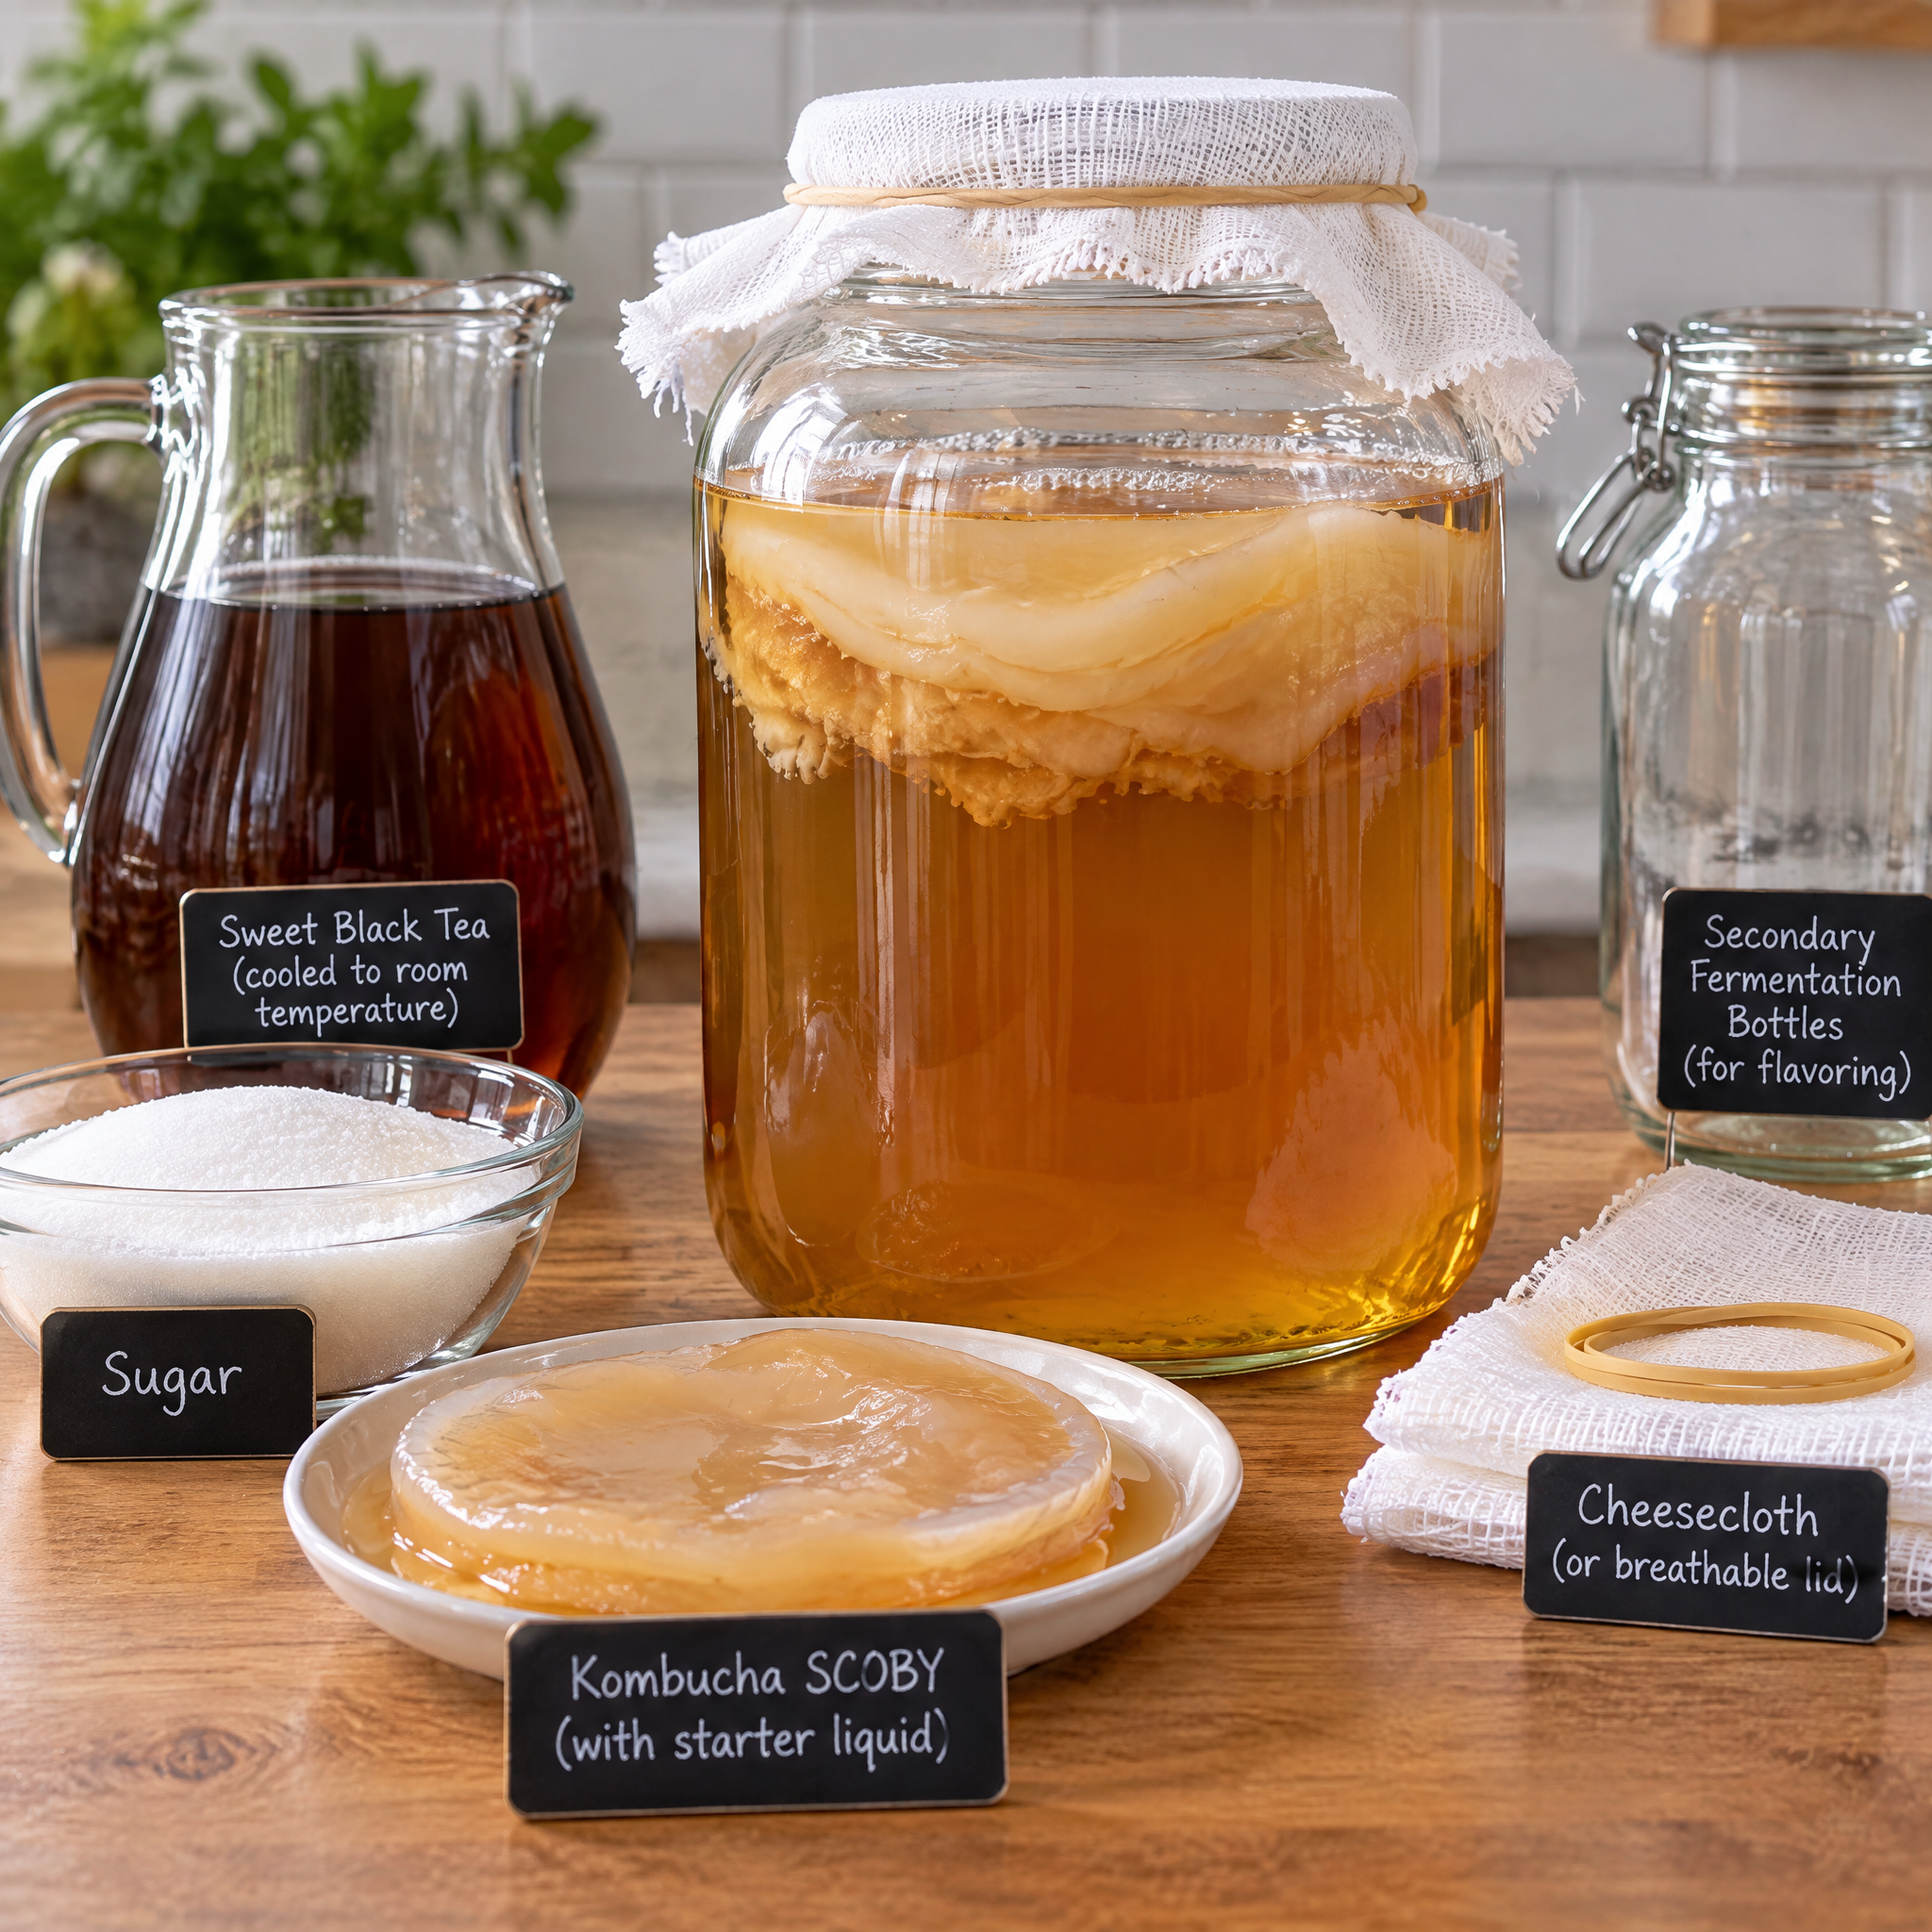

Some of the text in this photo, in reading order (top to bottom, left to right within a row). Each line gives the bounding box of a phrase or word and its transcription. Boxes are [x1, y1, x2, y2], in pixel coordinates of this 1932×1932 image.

[219, 907, 491, 949] Sweet Black Tea
[1704, 913, 1876, 967] Secondary
[233, 953, 468, 996] (cooled to room
[1690, 958, 1902, 997] Fermentation
[254, 987, 458, 1038] temperature)
[1727, 1004, 1843, 1041] Bottles
[1684, 1043, 1911, 1103] (for flavoring)
[101, 1350, 242, 1417] Sugar
[1577, 1482, 1819, 1538] Cheesecloth
[1552, 1537, 1858, 1605] (or breathable lid)
[571, 1647, 944, 1701] Kombucha SCOBY
[555, 1707, 950, 1773] (with starter liquid)
